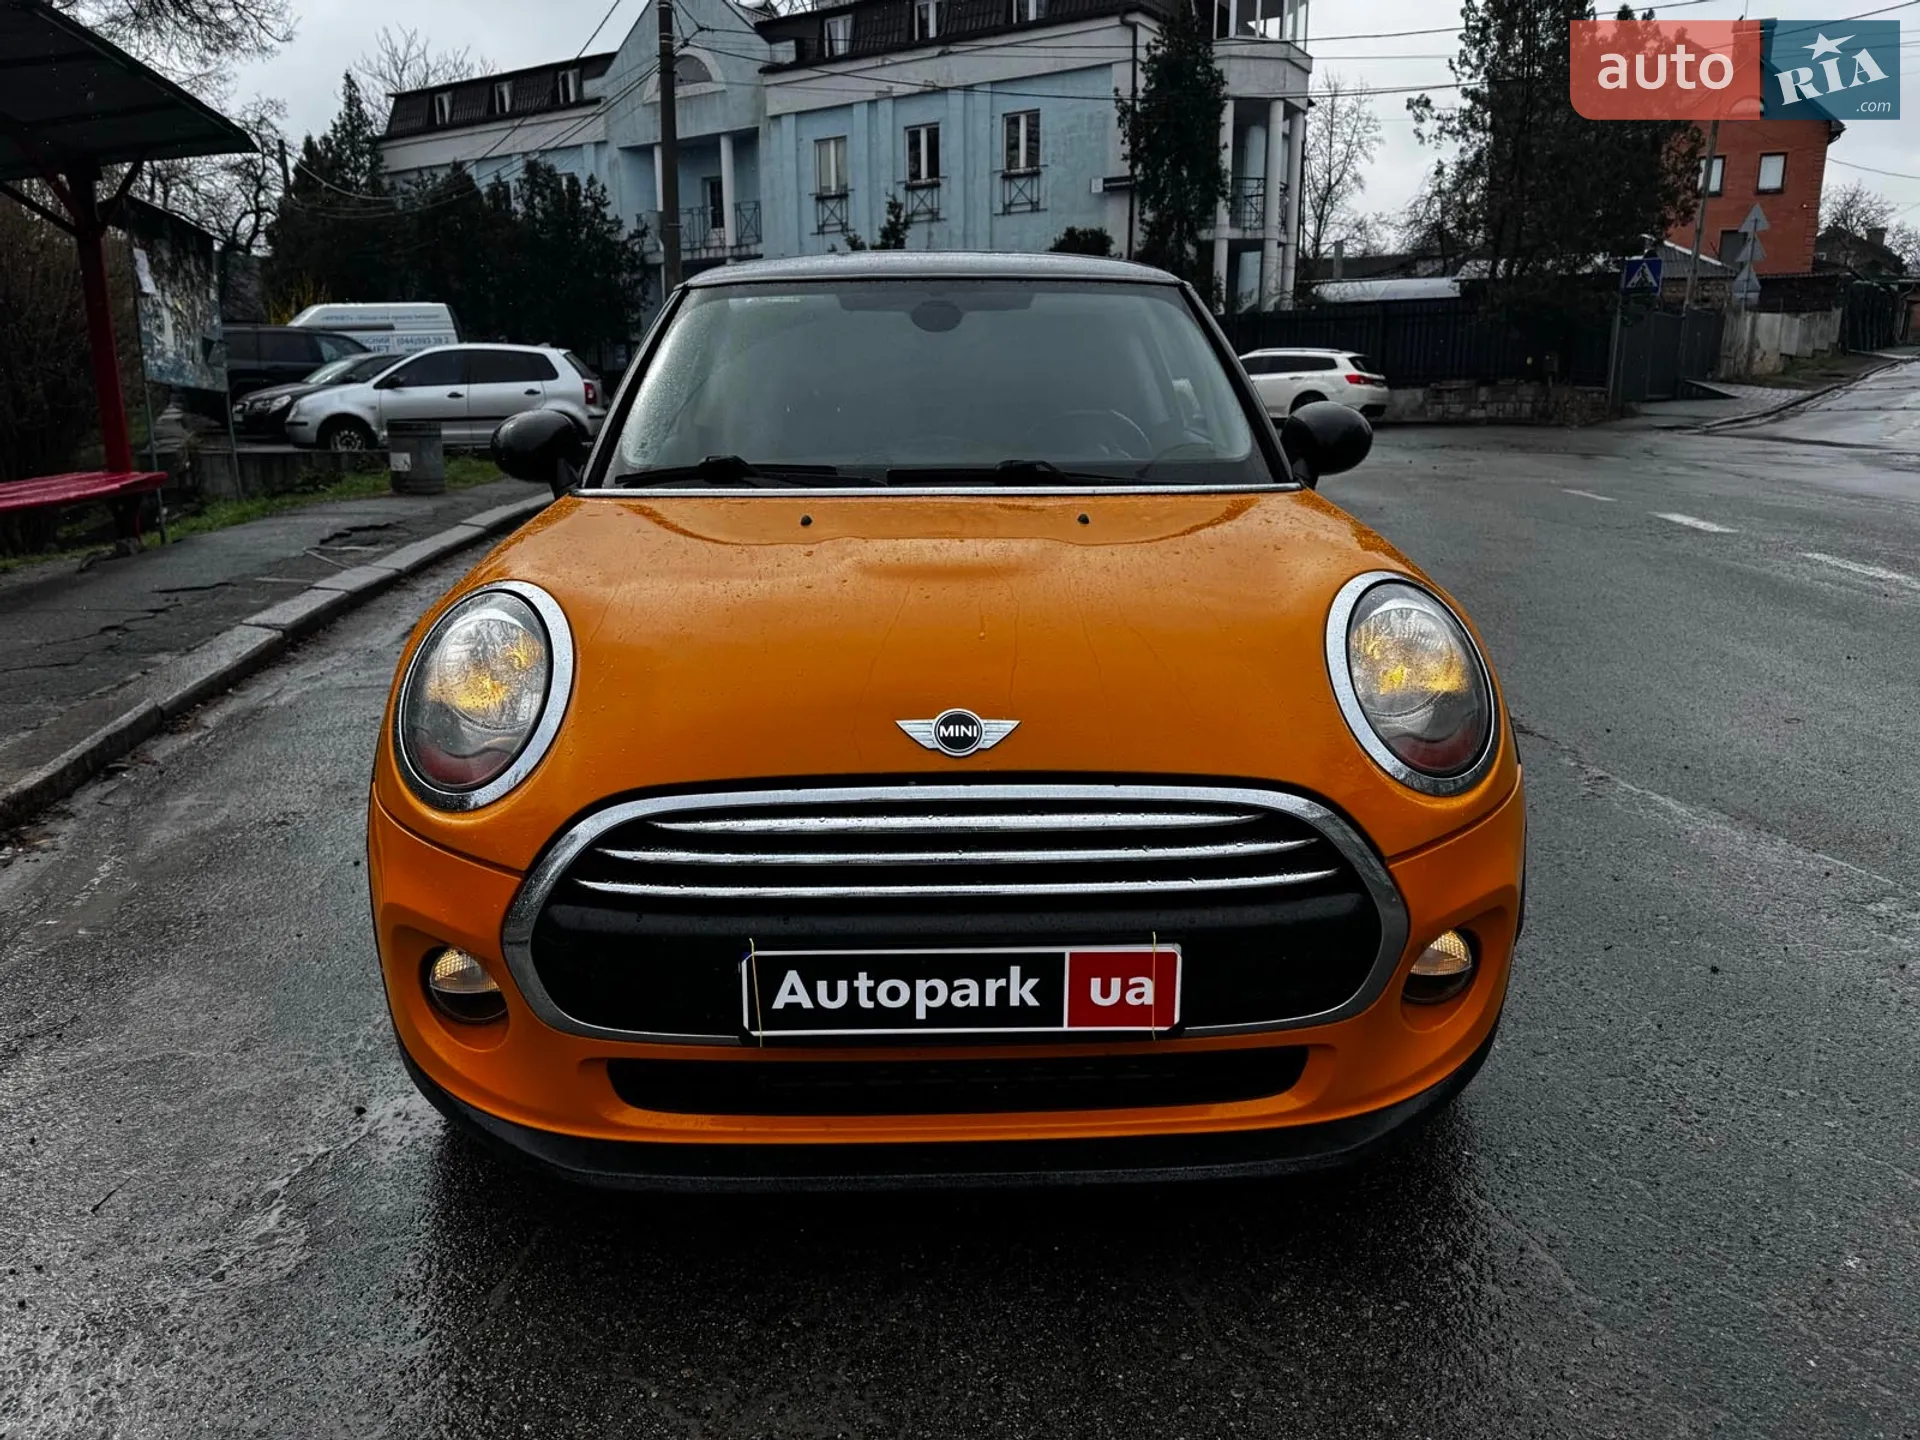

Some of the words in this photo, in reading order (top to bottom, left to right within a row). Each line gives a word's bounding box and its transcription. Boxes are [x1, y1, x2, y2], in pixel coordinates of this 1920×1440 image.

[940, 725, 978, 738] MINI
[771, 966, 1040, 1020] Autopark
[1090, 975, 1154, 1006] ua
